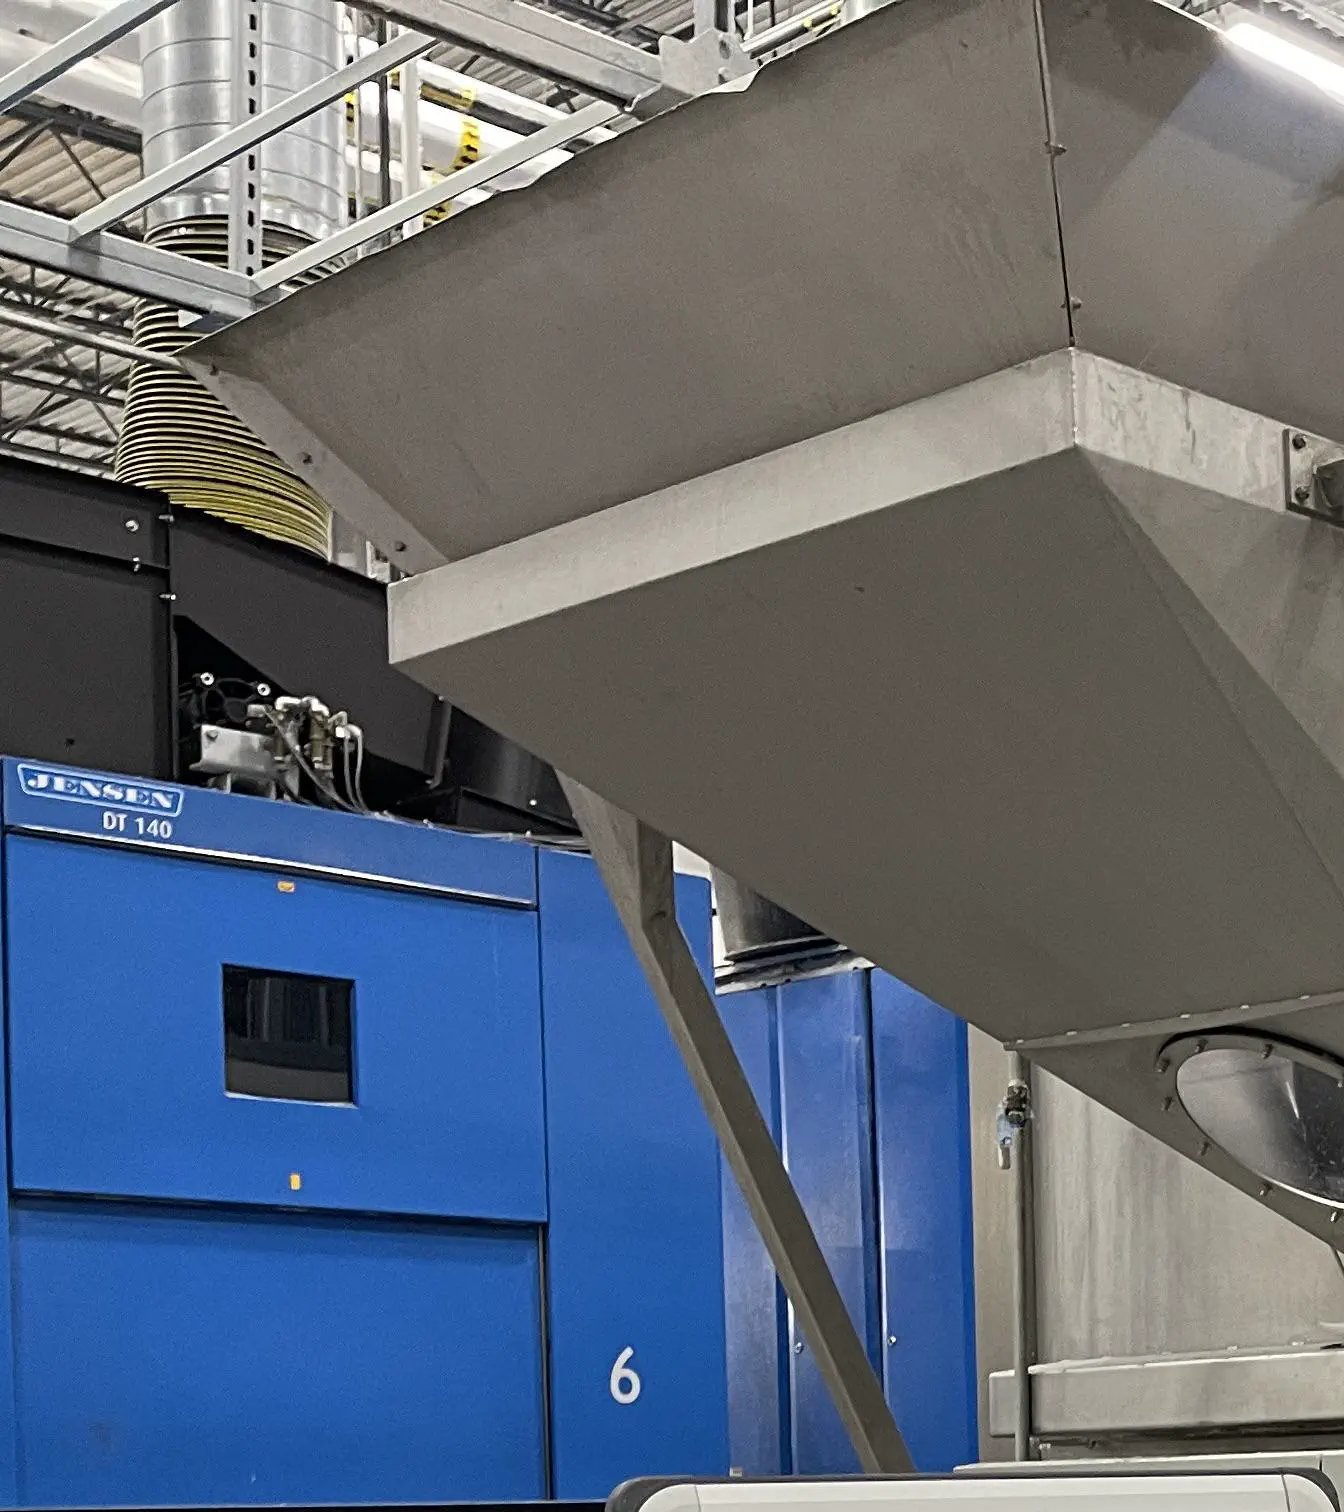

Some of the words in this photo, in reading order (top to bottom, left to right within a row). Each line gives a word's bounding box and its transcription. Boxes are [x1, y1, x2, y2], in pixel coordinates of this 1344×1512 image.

[27, 774, 174, 809] JENSEN
[103, 811, 129, 832] DT
[135, 817, 173, 840] 140
[610, 1346, 641, 1405] 6
